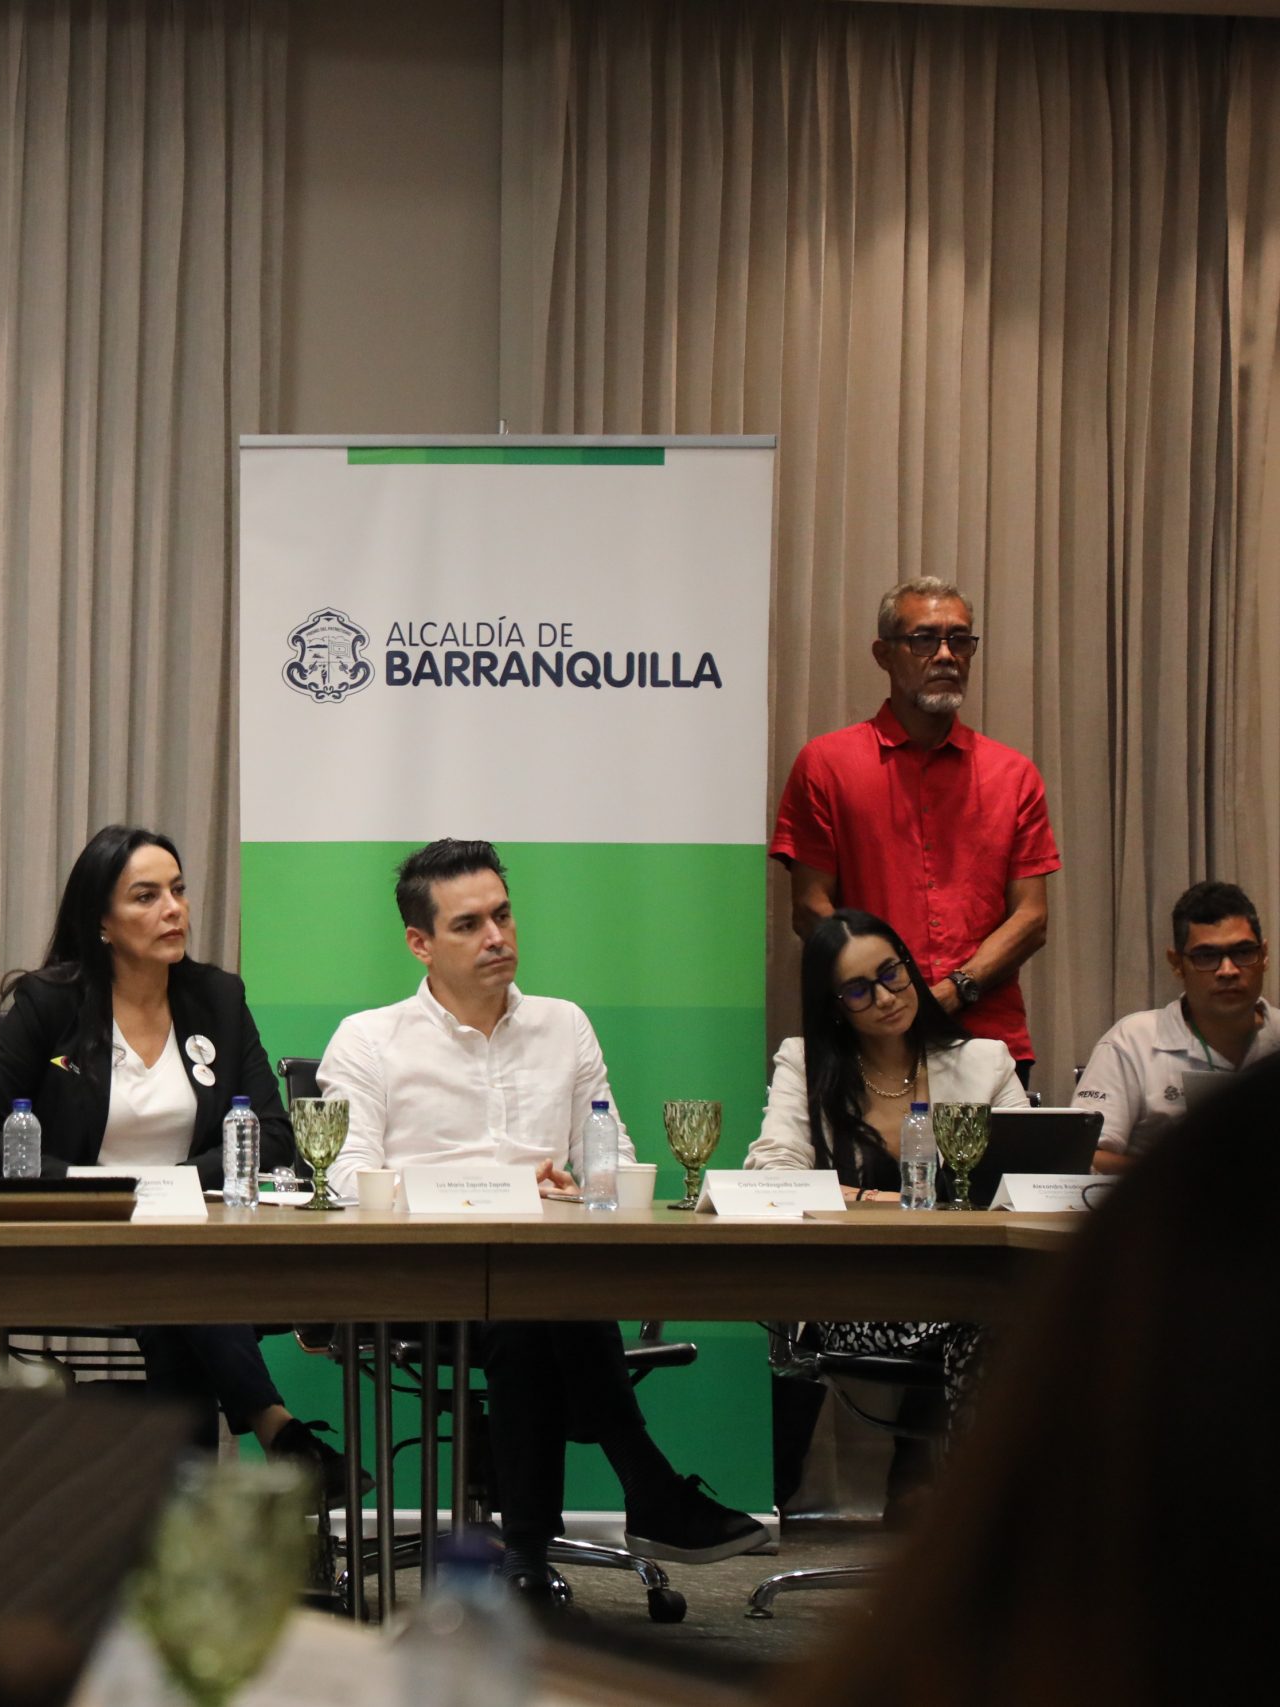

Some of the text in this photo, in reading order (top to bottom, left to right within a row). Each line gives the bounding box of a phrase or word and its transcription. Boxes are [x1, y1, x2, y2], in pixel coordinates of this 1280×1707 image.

[385, 615, 573, 648] ALCALDÍA DE
[385, 650, 723, 690] BARRANQUILLA
